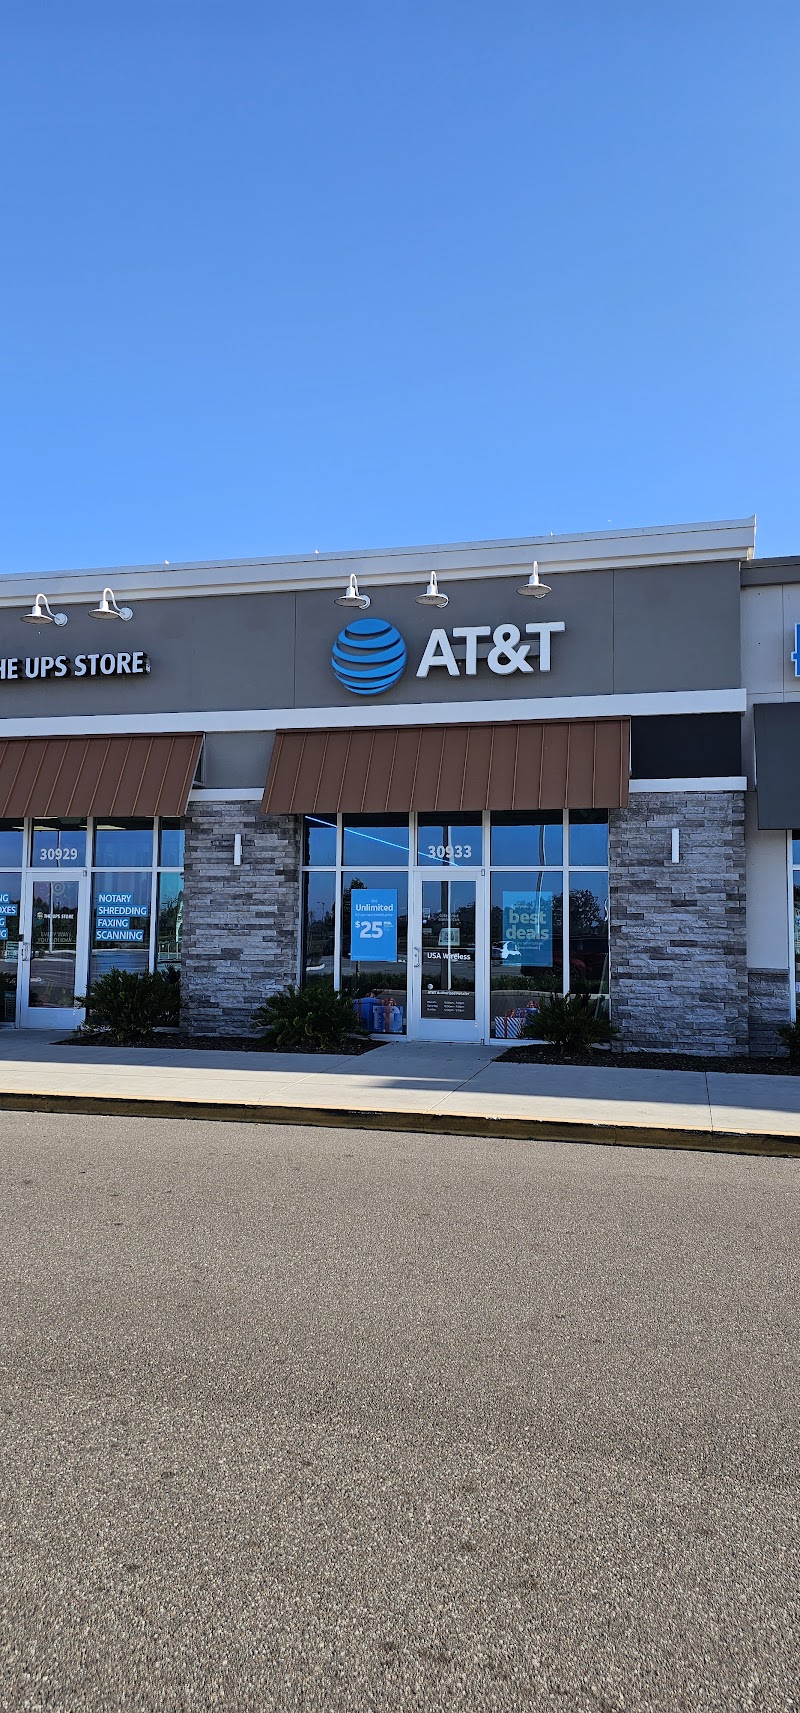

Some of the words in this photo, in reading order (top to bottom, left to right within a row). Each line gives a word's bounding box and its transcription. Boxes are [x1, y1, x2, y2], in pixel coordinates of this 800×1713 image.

[416, 621, 566, 679] AT&T
[25, 655, 67, 679] UPS
[74, 651, 145, 677] STORE
[40, 848, 78, 860] 30929
[428, 845, 472, 859] 30933
[98, 894, 132, 903] NOTARY
[98, 906, 147, 915] SHREDDING
[355, 903, 394, 912] Unlimited
[508, 909, 547, 924] best
[97, 919, 129, 928] FAXING
[96, 930, 143, 940] SCANNING
[505, 924, 550, 940] deals
